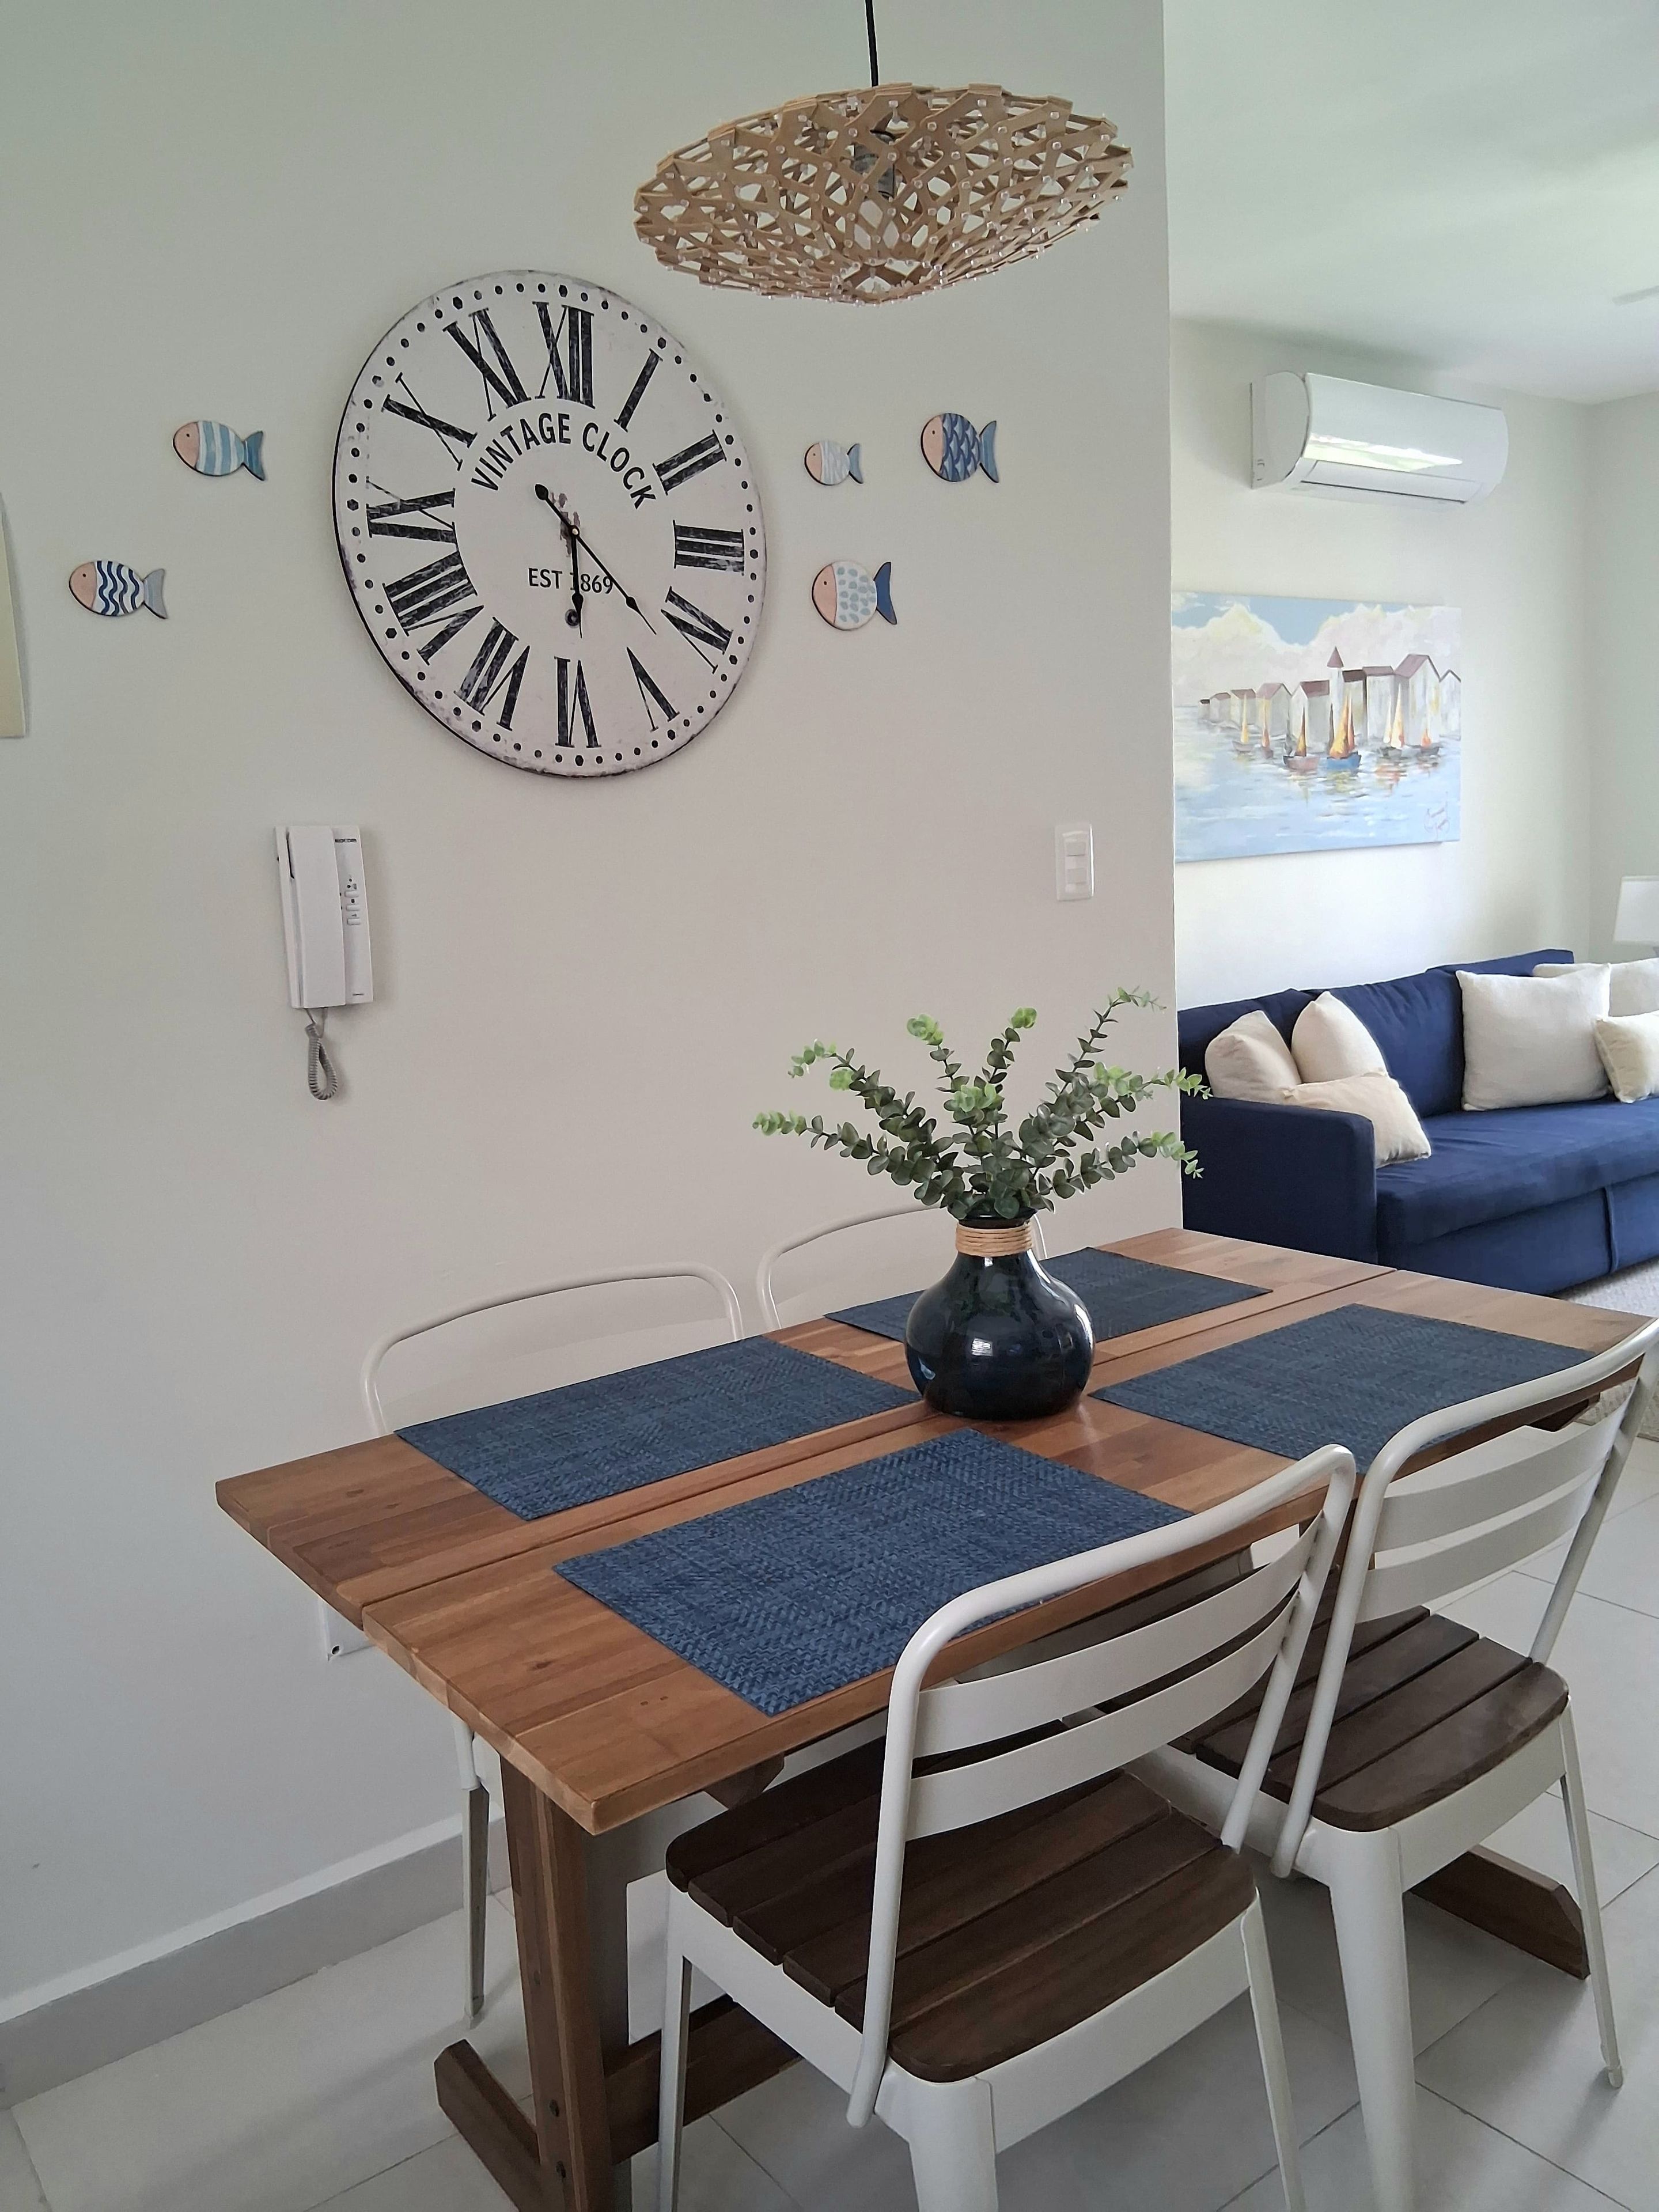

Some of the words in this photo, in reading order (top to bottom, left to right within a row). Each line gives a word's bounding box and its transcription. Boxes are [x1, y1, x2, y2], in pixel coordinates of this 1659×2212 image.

[444, 307, 532, 422] XI
[533, 301, 596, 408] XII
[614, 349, 663, 431] I
[381, 373, 478, 470] X
[471, 412, 571, 491] VINTAGE
[582, 421, 657, 509] CLOCK
[652, 429, 728, 495] II
[528, 567, 562, 589] EST
[569, 572, 614, 594] 869
[674, 520, 745, 574] III
[554, 656, 601, 748] VI
[627, 646, 680, 731] V
